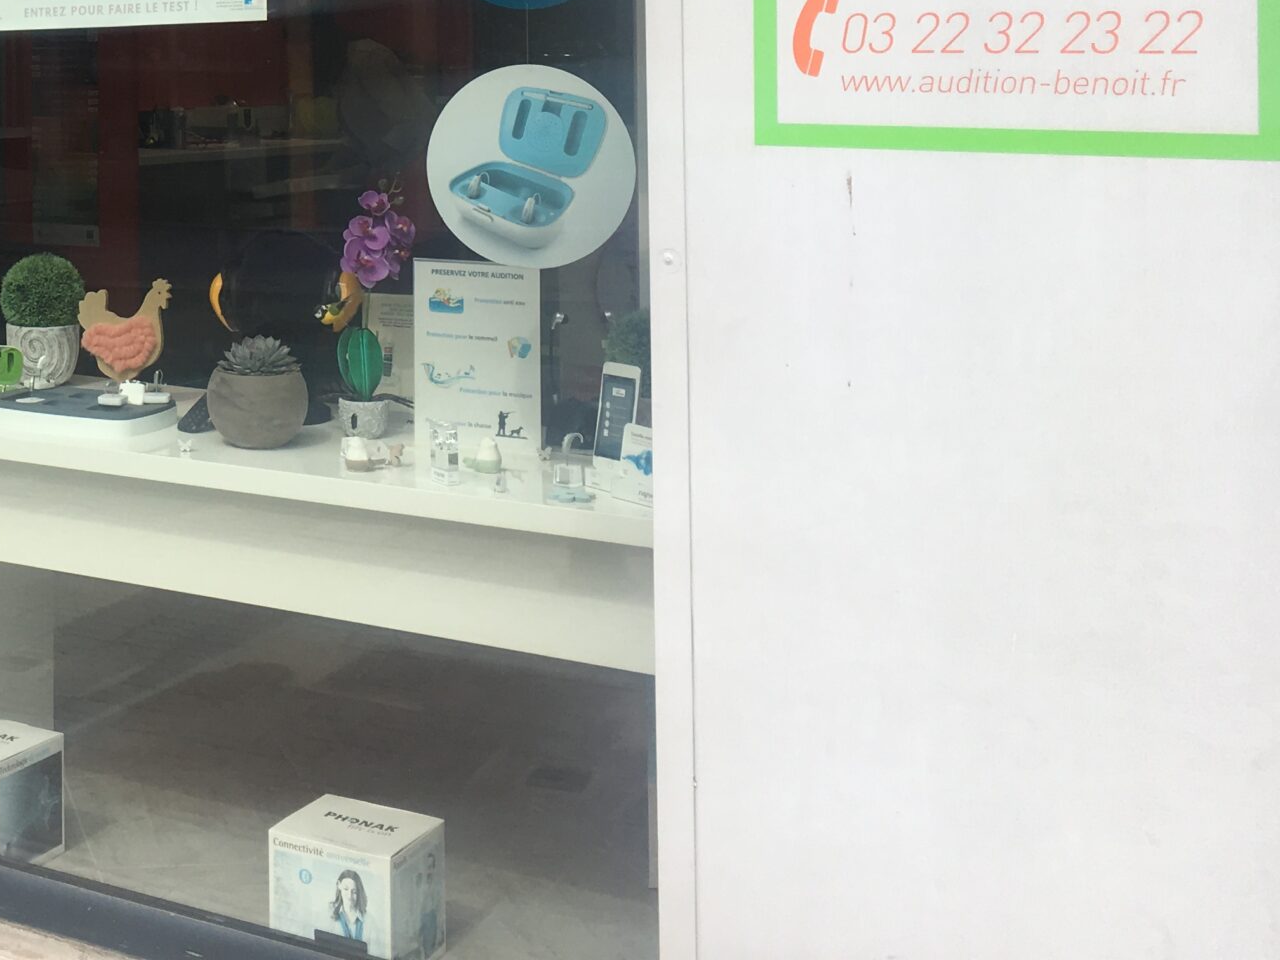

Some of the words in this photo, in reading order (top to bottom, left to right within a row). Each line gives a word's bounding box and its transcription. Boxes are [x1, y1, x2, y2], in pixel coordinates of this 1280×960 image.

[24, 6, 66, 18] ENTREZ
[71, 5, 104, 16] POUR
[108, 3, 141, 15] FAIRE
[146, 2, 158, 13] LE
[162, 1, 190, 12] TEST
[840, 11, 896, 54] 03
[910, 11, 971, 54] 22
[982, 10, 1046, 54] 32
[1060, 10, 1122, 54] 23
[1138, 10, 1205, 55] 22
[840, 68, 1187, 98] www.audition-benoit.fr
[431, 269, 466, 277] PRESERVEZ
[468, 270, 489, 278] VOTRE
[491, 272, 524, 280] AUDITION
[324, 811, 400, 833] PHONAK
[273, 837, 324, 857] Connectivité
